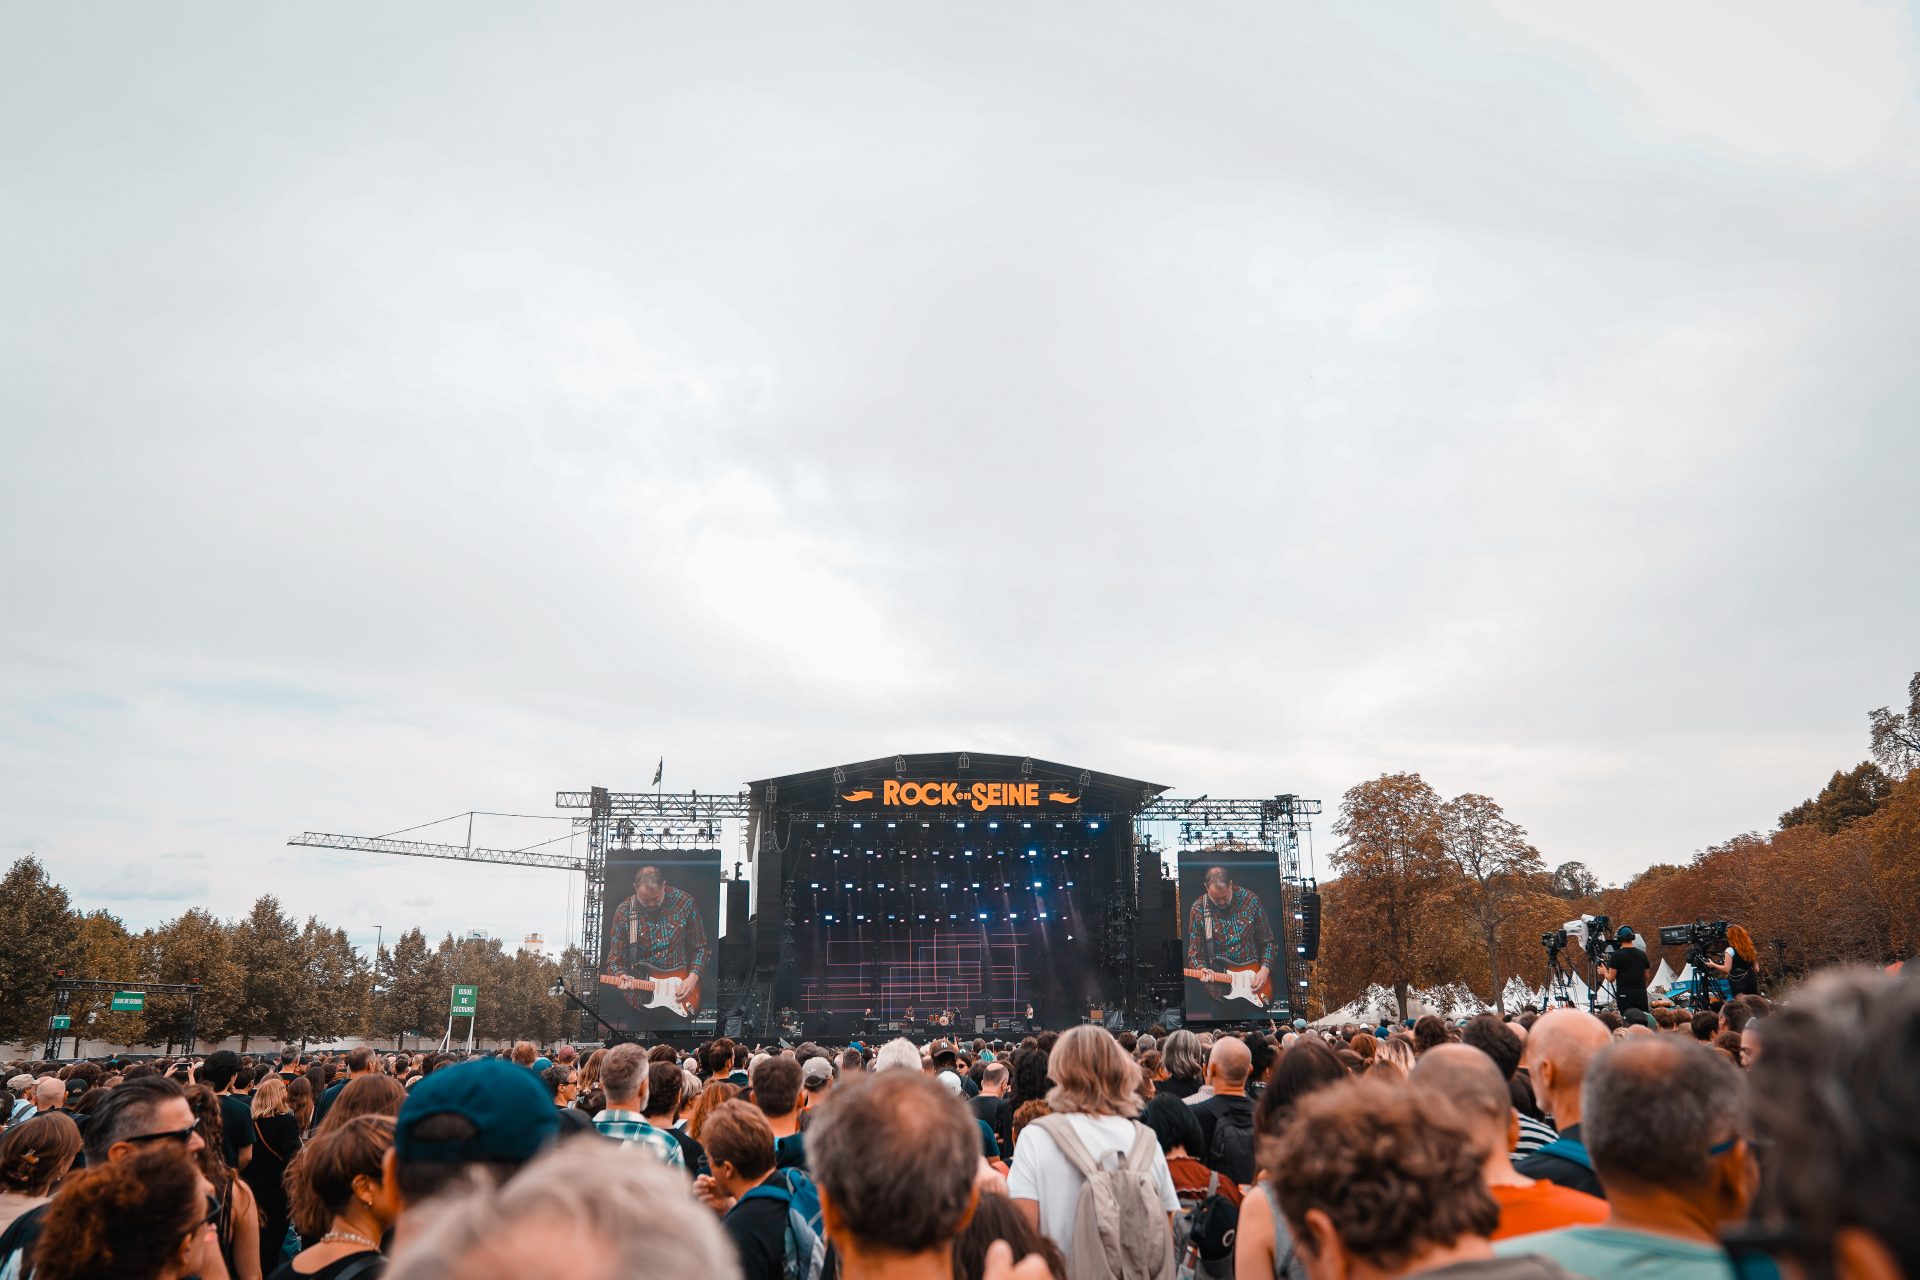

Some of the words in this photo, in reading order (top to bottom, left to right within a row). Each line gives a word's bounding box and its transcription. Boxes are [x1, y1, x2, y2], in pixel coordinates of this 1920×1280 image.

[883, 780, 958, 805] ROCK
[956, 791, 971, 800] en
[971, 782, 1039, 812] SEINE
